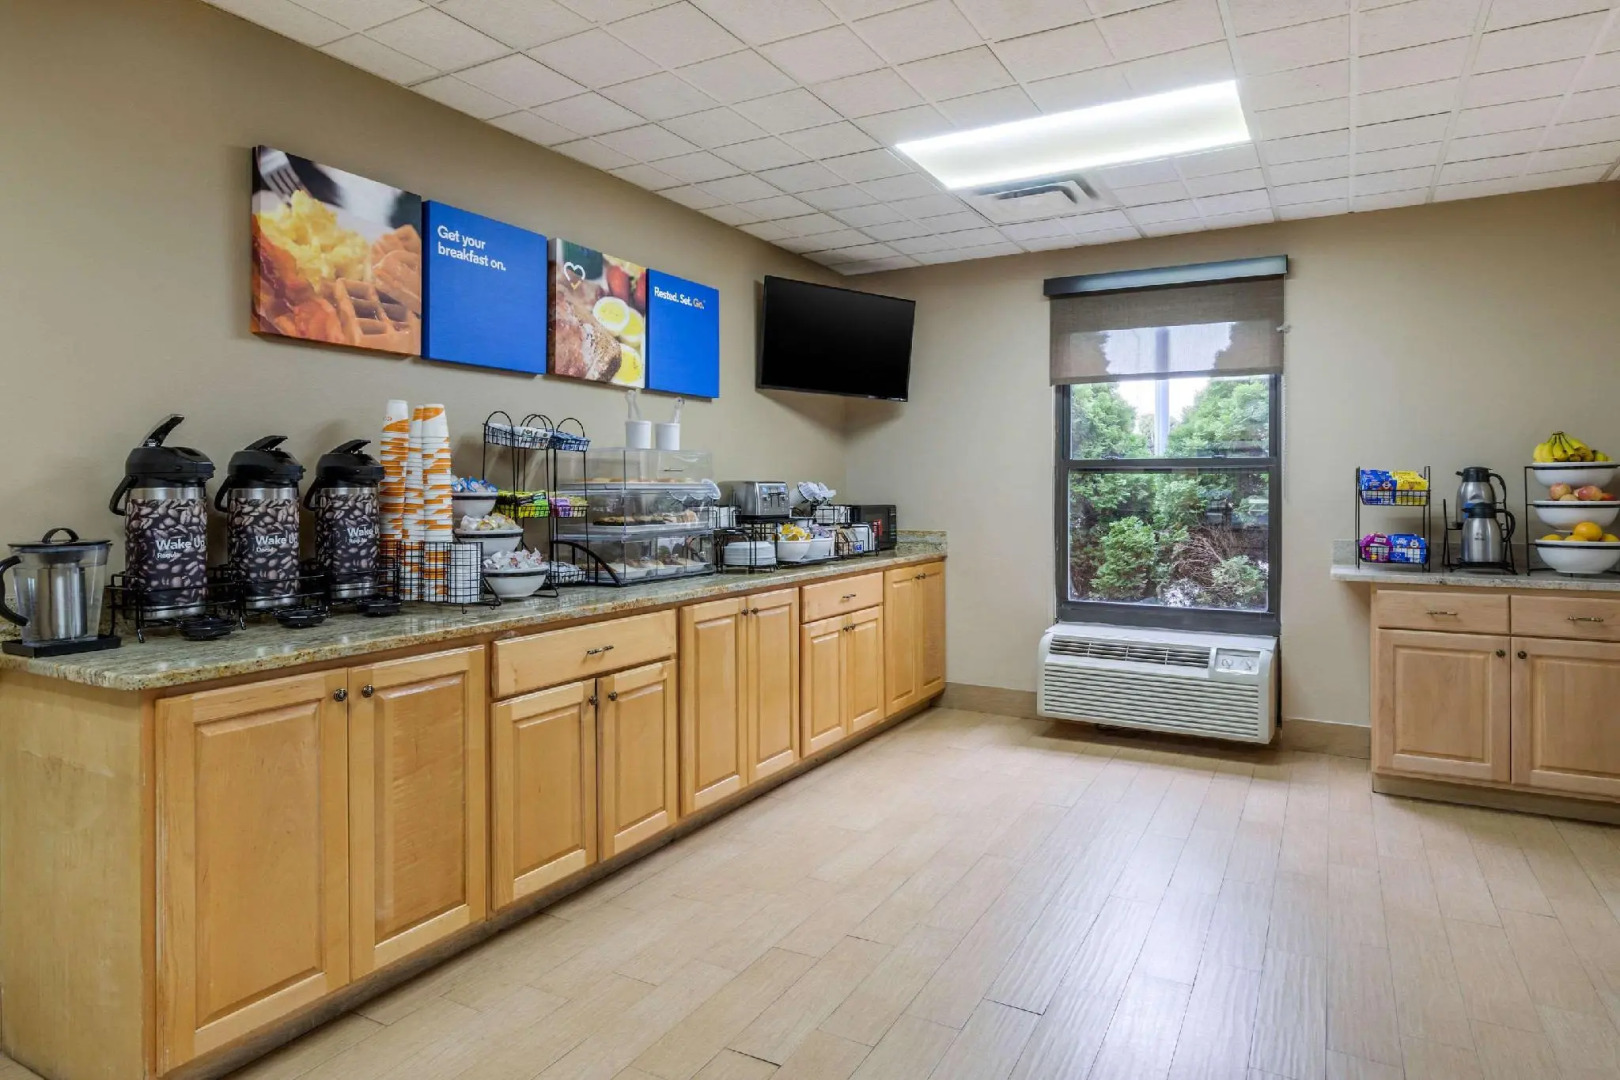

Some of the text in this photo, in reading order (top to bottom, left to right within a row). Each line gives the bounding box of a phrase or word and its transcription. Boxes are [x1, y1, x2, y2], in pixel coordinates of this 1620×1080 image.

[437, 225, 486, 250] Get your
[437, 241, 507, 271] breakfast on.
[654, 286, 679, 303] Rested.
[680, 294, 692, 307] Set.
[255, 535, 287, 546] Wake
[347, 526, 374, 538] Wake
[155, 535, 205, 551] Wake Up
